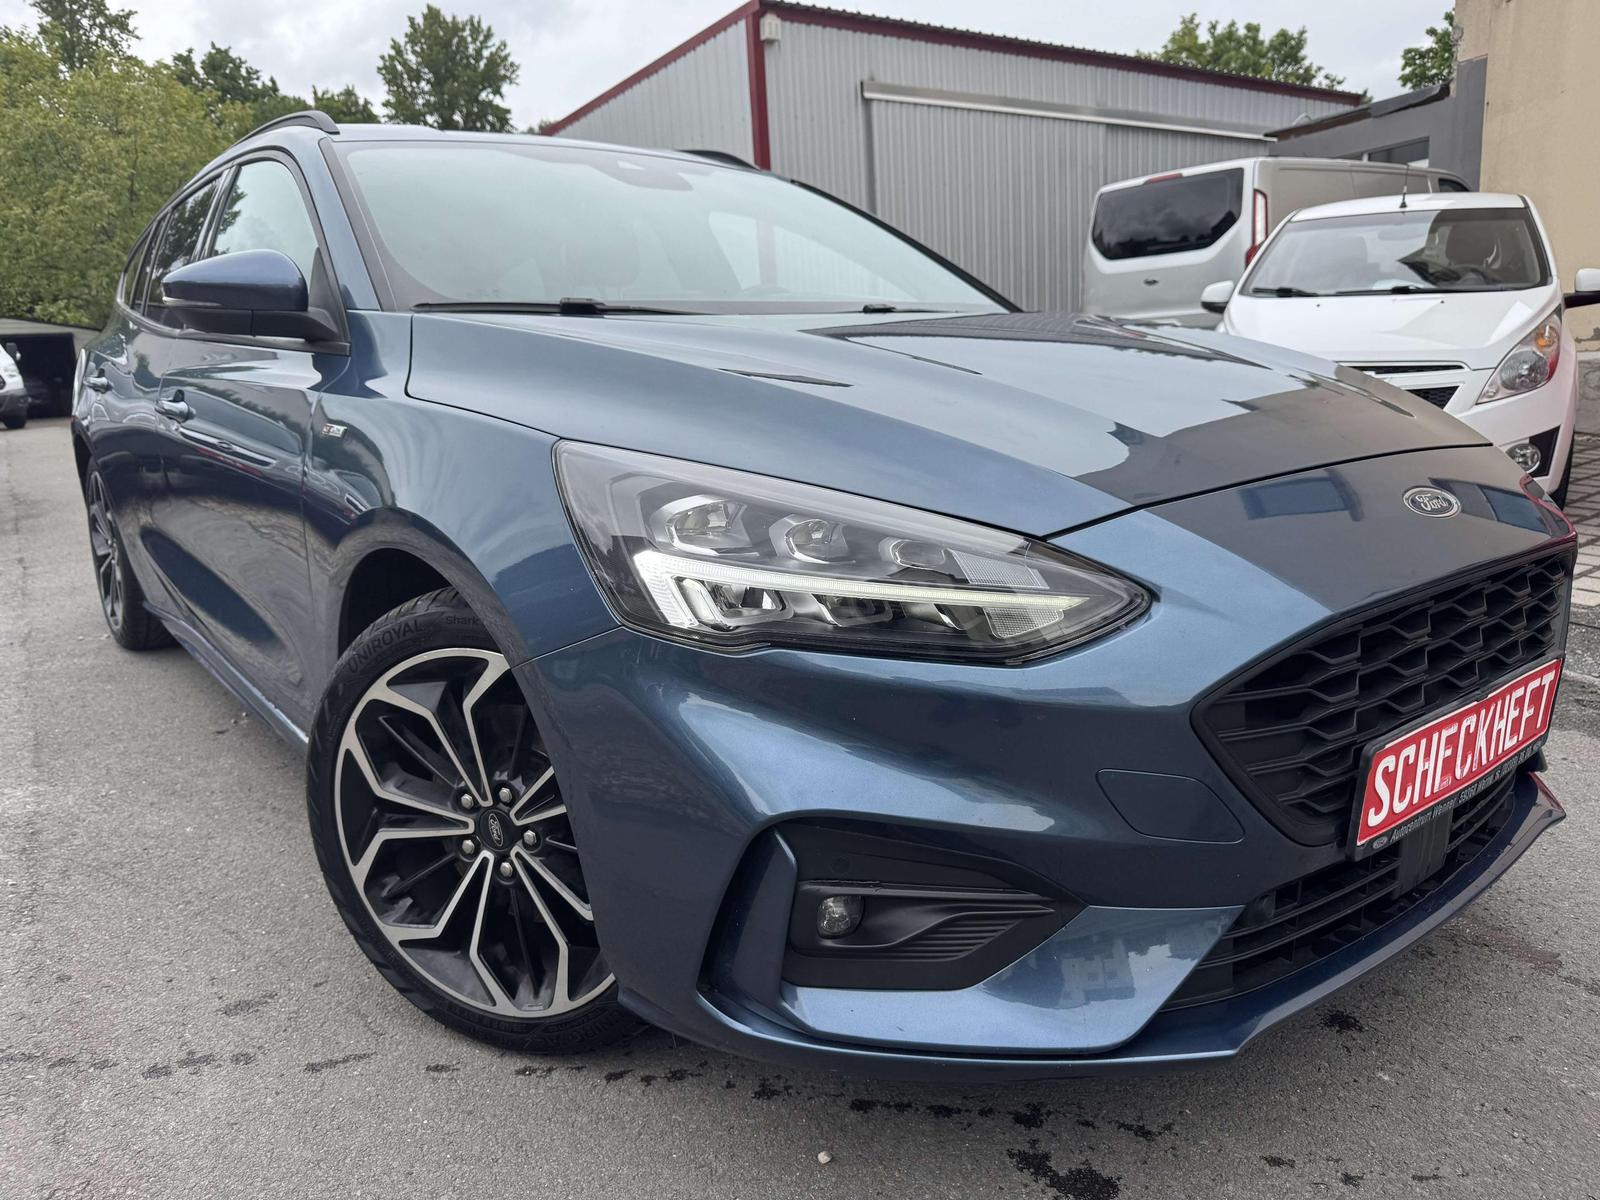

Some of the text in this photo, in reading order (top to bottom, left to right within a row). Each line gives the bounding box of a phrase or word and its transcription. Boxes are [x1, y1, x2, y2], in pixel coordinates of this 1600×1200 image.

[1415, 493, 1449, 511] Ford
[347, 619, 423, 674] UNIROYAL
[1367, 670, 1555, 827] SCHECKHEFT
